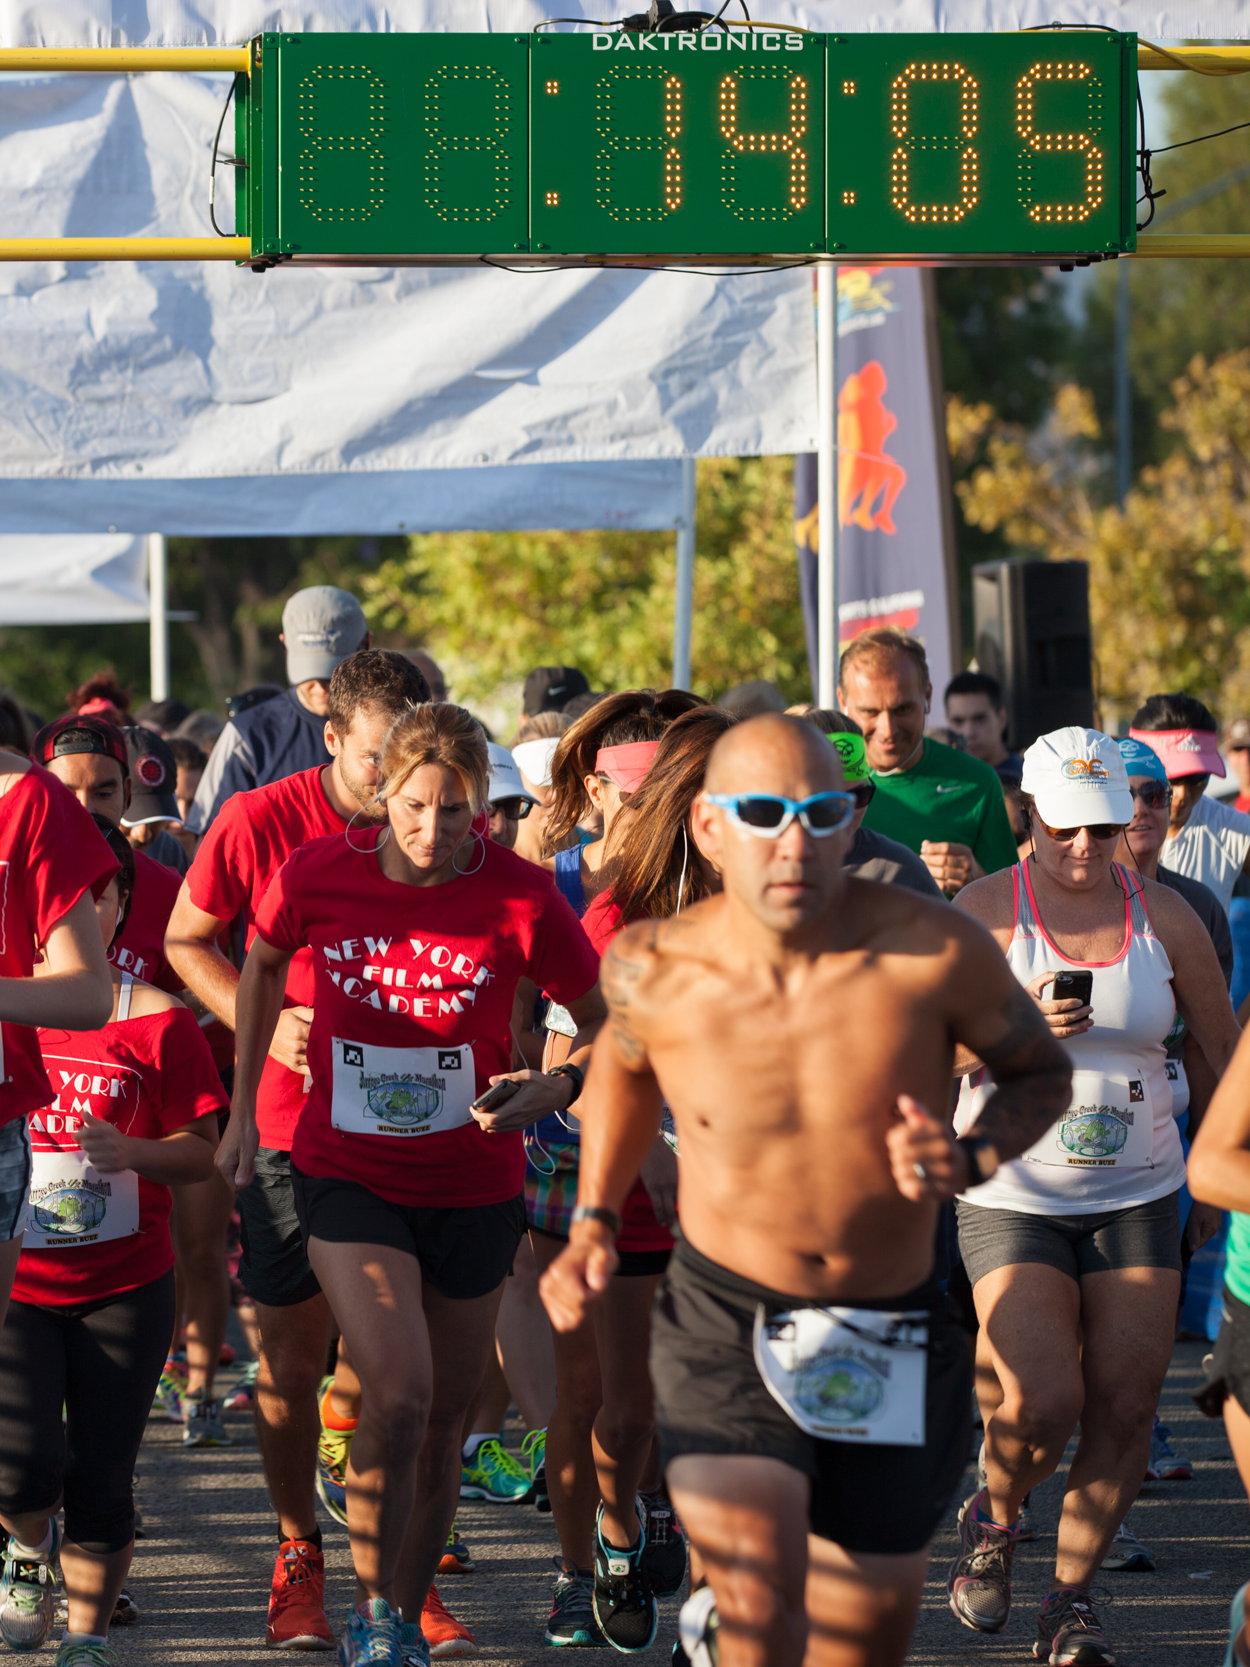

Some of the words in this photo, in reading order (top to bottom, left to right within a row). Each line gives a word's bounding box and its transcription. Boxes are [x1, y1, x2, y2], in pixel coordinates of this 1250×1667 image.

[592, 32, 804, 51] DAKTRONICS
[323, 935, 393, 966] NEW
[409, 937, 496, 987] YORK
[362, 964, 444, 990] FILM
[325, 968, 478, 1018] ACADEMY
[58, 1070, 127, 1099] YORK
[380, 1072, 399, 1083] Creek
[378, 1125, 410, 1134] RUNNER
[410, 1124, 431, 1134] BUZZ
[1068, 1158, 1097, 1166] RUNNER
[1097, 1158, 1117, 1166] BUZZ
[48, 1178, 67, 1192] Creek
[47, 1237, 79, 1246] RUNNER
[79, 1233, 99, 1243] BUZZ
